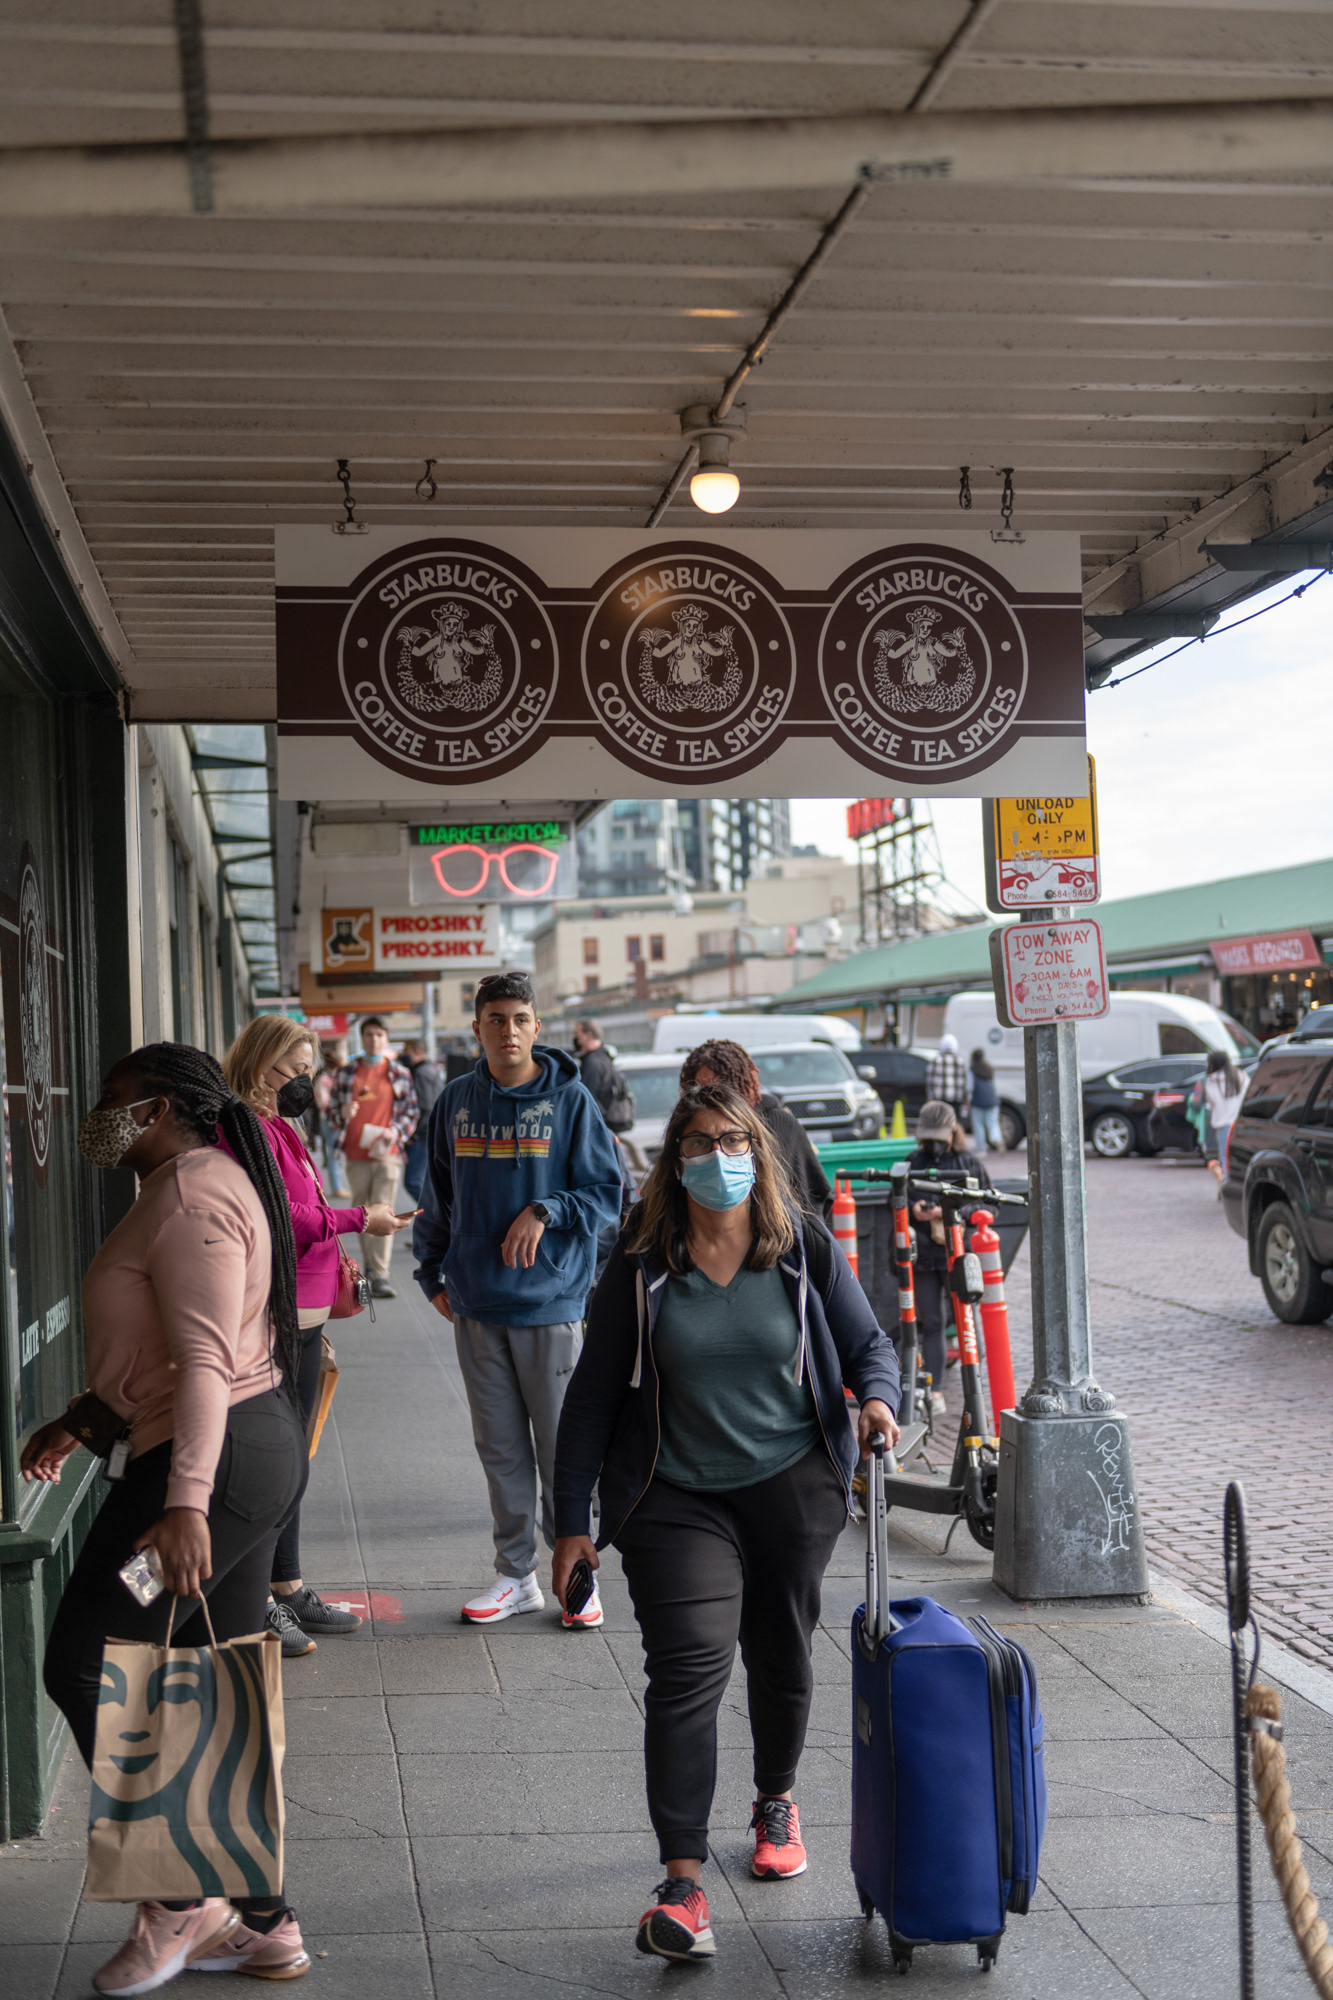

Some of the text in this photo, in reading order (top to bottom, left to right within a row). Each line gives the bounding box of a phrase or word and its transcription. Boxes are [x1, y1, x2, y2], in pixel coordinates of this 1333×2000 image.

[379, 564, 519, 610] STARBUCKS
[620, 567, 756, 611] STARBUCKS
[856, 569, 989, 612] STARBUCKS
[354, 681, 546, 763] COFFEE TEA SPICES
[597, 682, 784, 763] COFFEE TEA SPICES
[834, 682, 1017, 763] COFFEE TEA SPICES
[1016, 797, 1074, 811] UNLOAD
[1027, 812, 1064, 825] ONLY
[419, 825, 493, 845] MARKET
[1007, 892, 1028, 900] Phone
[380, 915, 487, 934] PIROSHKY,
[1013, 929, 1091, 949] TOW AWAY
[1034, 949, 1075, 966] ZONE
[1021, 970, 1060, 983] 2:30AM
[1069, 967, 1092, 979] 6AM
[1058, 980, 1078, 990] DAYS
[1024, 1007, 1047, 1015] Phone
[453, 1123, 552, 1140] HOLLYWOOD
[21, 1320, 40, 1367] LATTE
